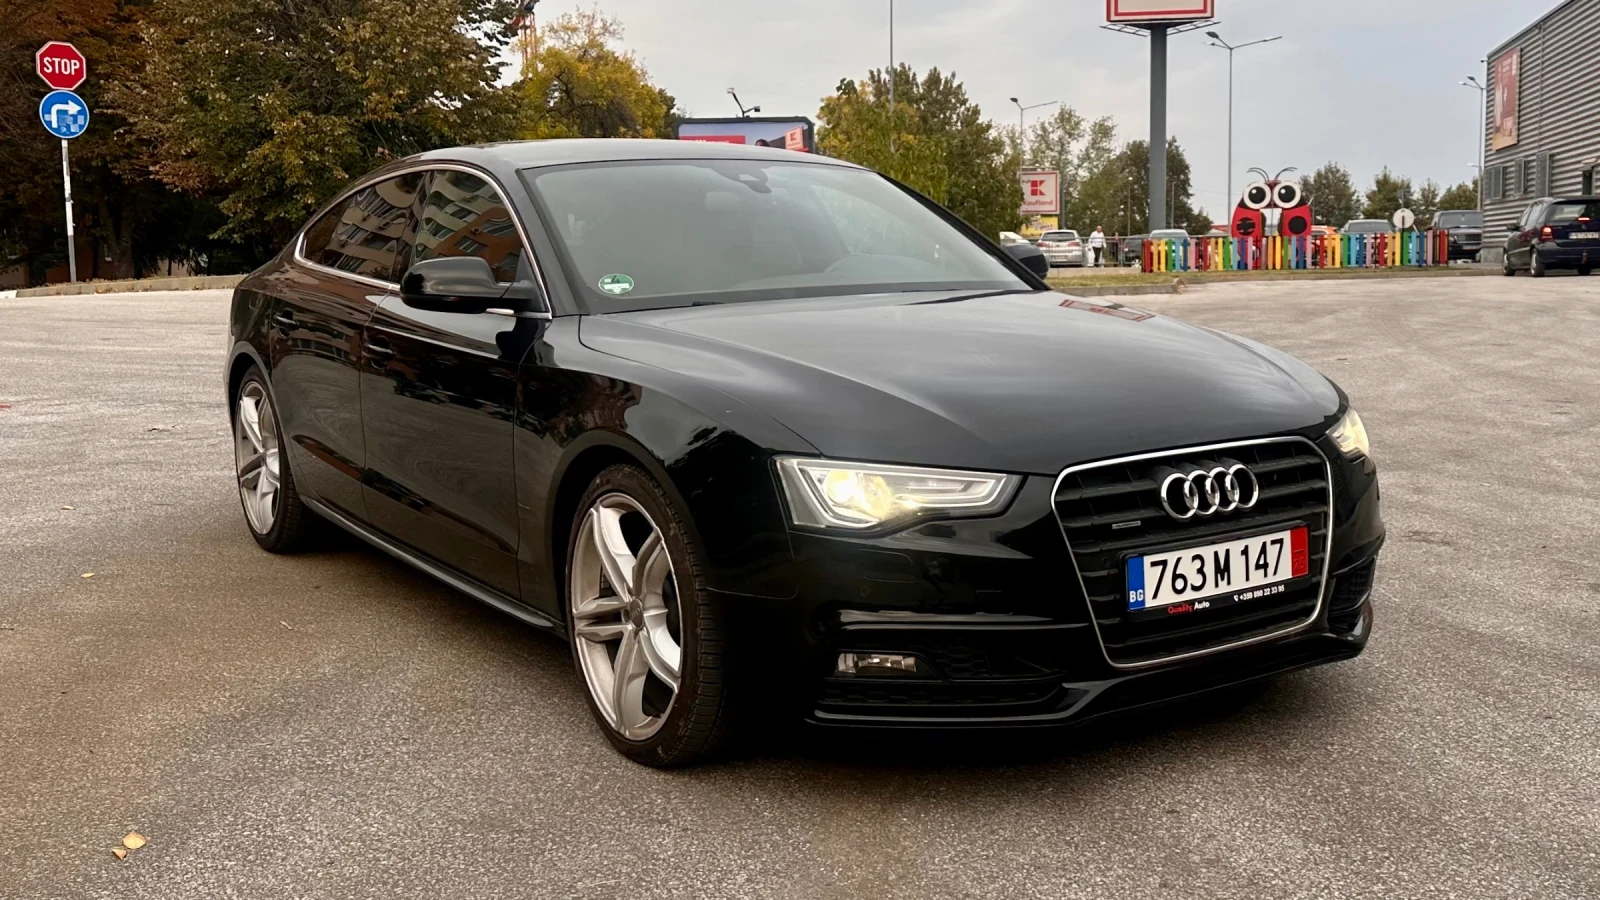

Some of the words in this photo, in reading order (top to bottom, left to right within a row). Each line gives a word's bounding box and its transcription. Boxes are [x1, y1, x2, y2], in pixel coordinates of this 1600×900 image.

[43, 56, 80, 75] STOP
[1031, 180, 1046, 196] K
[1150, 553, 1207, 600] 763
[1213, 548, 1231, 589] M
[1240, 538, 1284, 582] 147
[1129, 589, 1144, 602] BG
[1240, 592, 1253, 600] +359
[1263, 587, 1271, 595] 22
[1271, 586, 1278, 594] 33
[1167, 603, 1193, 614] Quality
[1194, 601, 1210, 610] Auto
